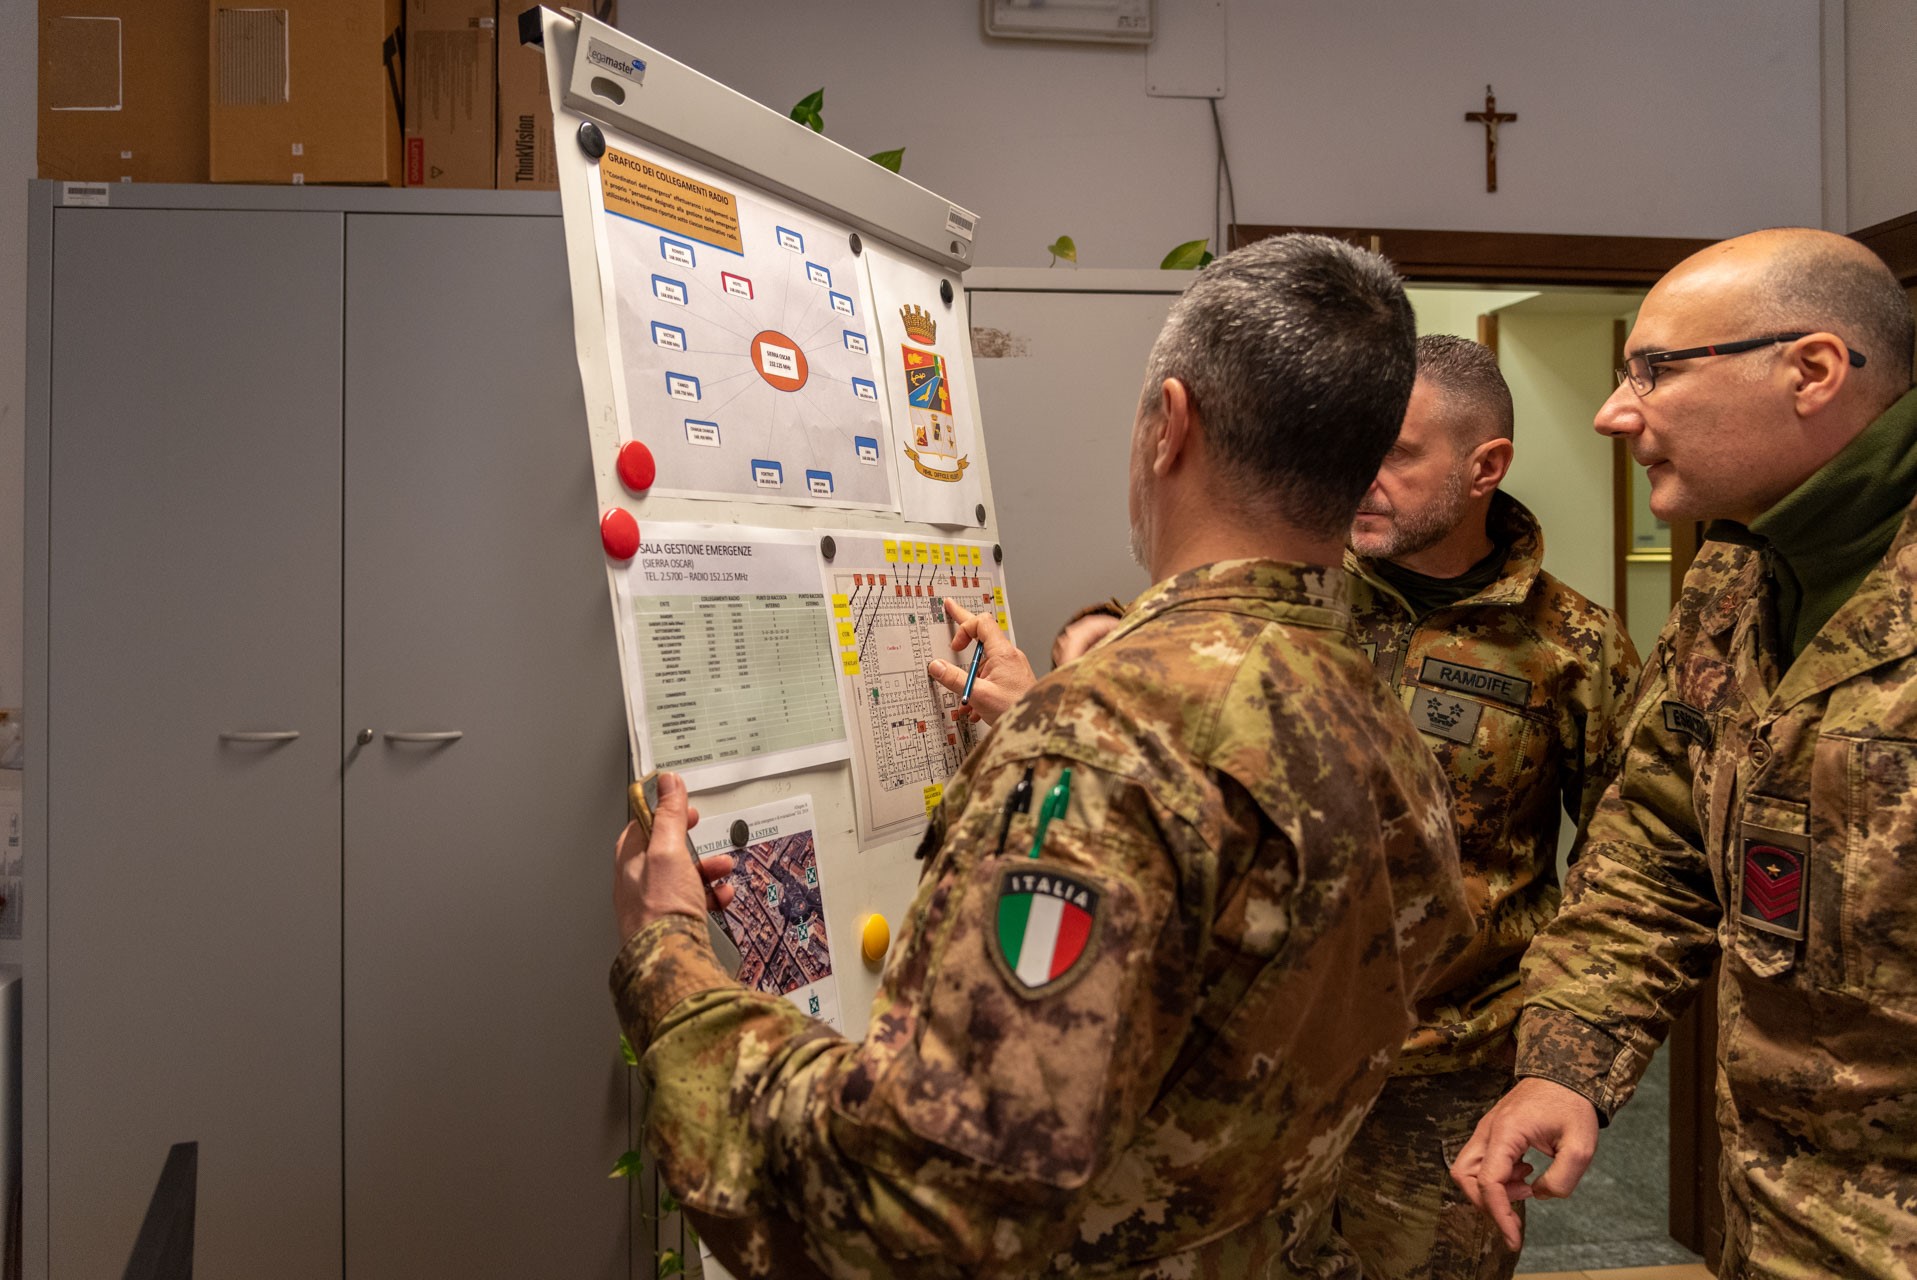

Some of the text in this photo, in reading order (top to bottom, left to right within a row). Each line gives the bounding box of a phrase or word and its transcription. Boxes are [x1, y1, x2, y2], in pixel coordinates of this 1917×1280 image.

[411, 142, 422, 182] Lenovo
[515, 113, 535, 183] ThinkVision
[608, 152, 728, 206] GRAFICO DEI COLLEGAMENTI RADIO
[640, 544, 752, 556] SALA GESTIONE EMERGENZE
[642, 558, 694, 570] (SIERRA OSCAR)
[660, 572, 683, 581] 2.5700
[689, 572, 708, 581] RADIO
[710, 572, 734, 582] 152.125
[734, 572, 748, 582] MHz
[1440, 666, 1512, 696] RAMDIFE
[696, 843, 714, 853] PUNTI
[755, 826, 778, 838] ESTERNI
[1012, 875, 1088, 908] ITALIA
